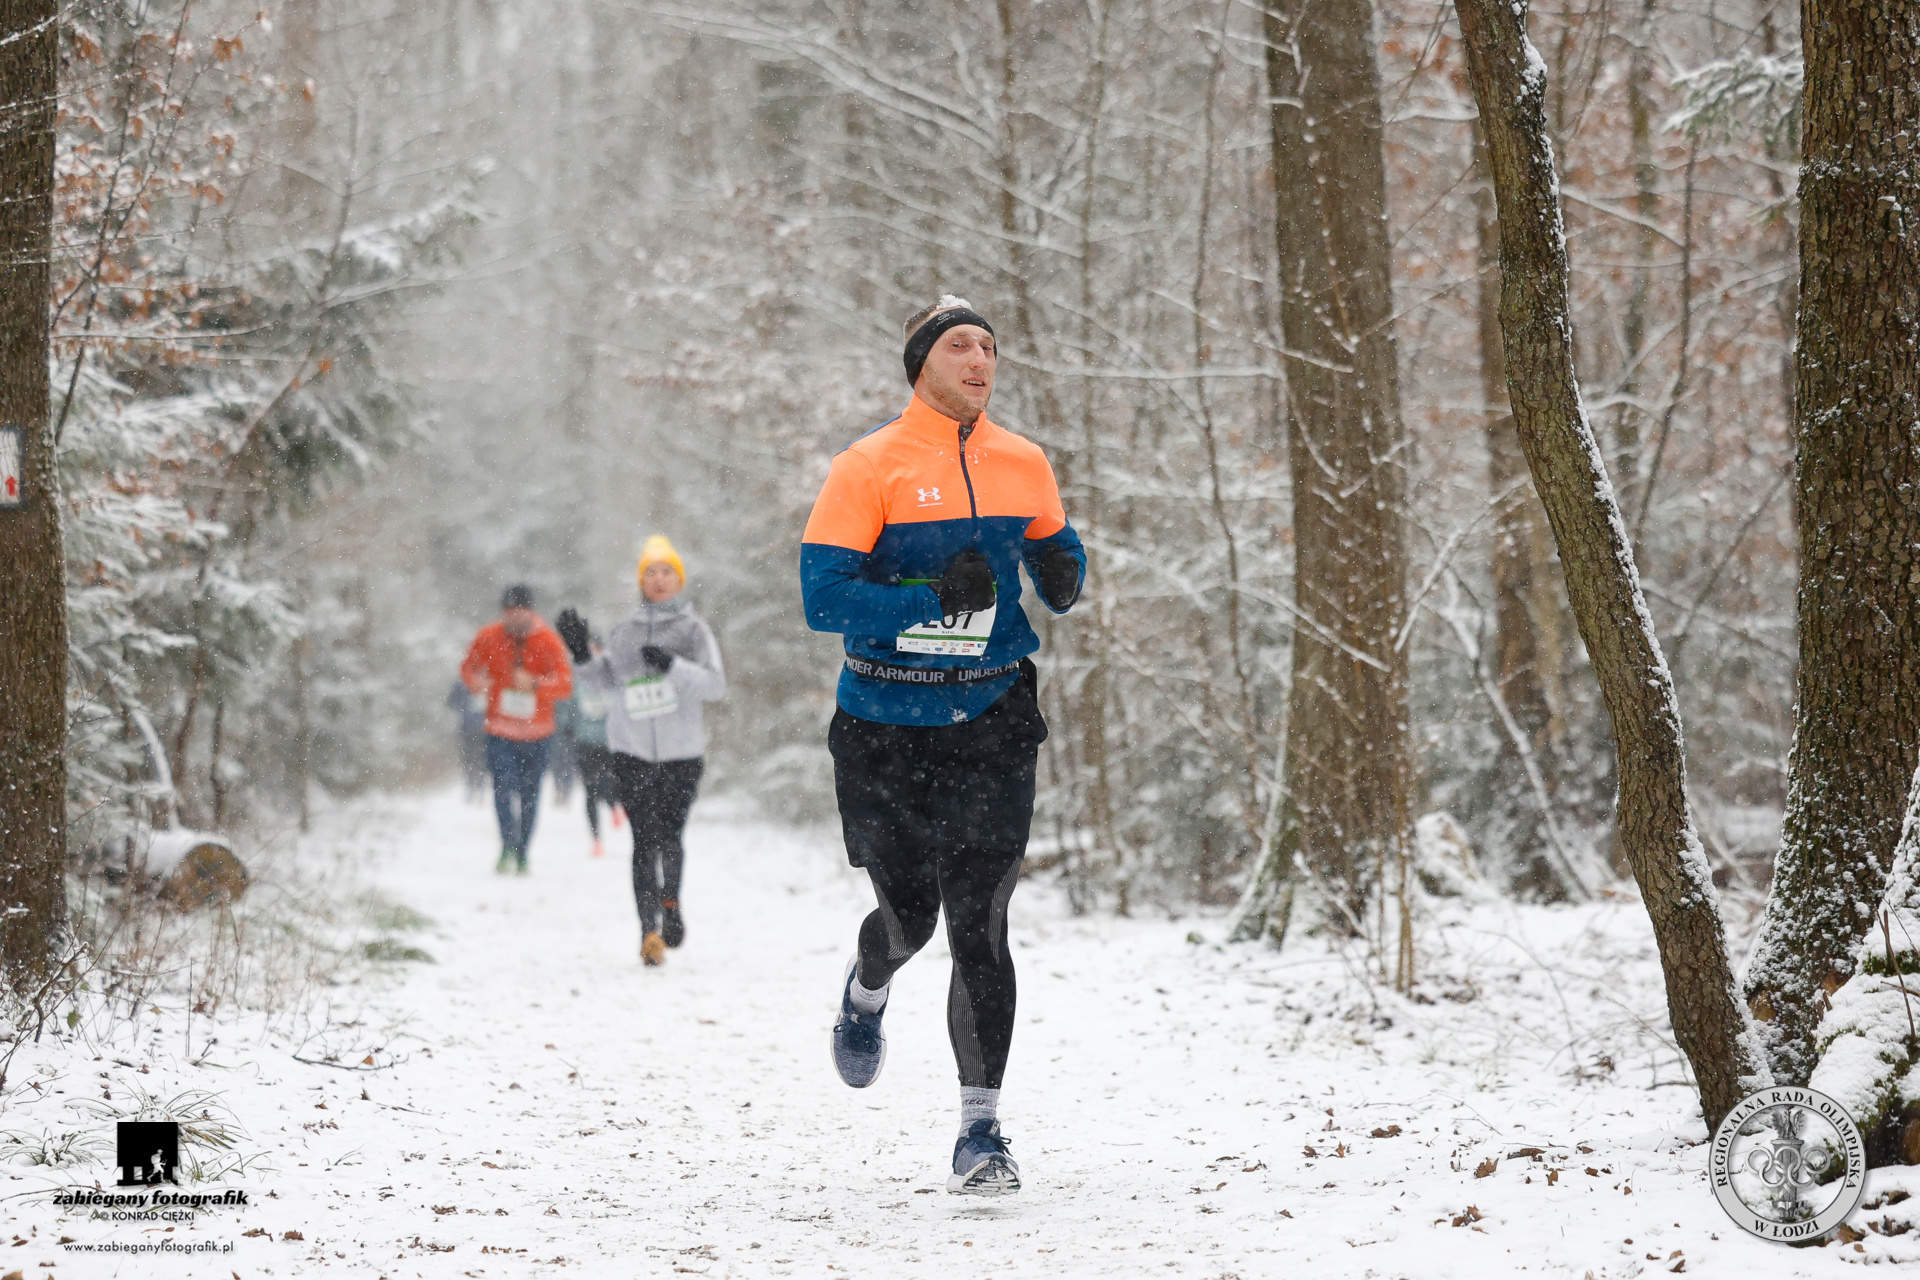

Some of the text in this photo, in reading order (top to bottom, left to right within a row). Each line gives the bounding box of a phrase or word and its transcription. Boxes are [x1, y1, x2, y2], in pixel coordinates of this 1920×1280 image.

[922, 611, 973, 629] 07
[846, 657, 945, 682] NDER ARMOUR
